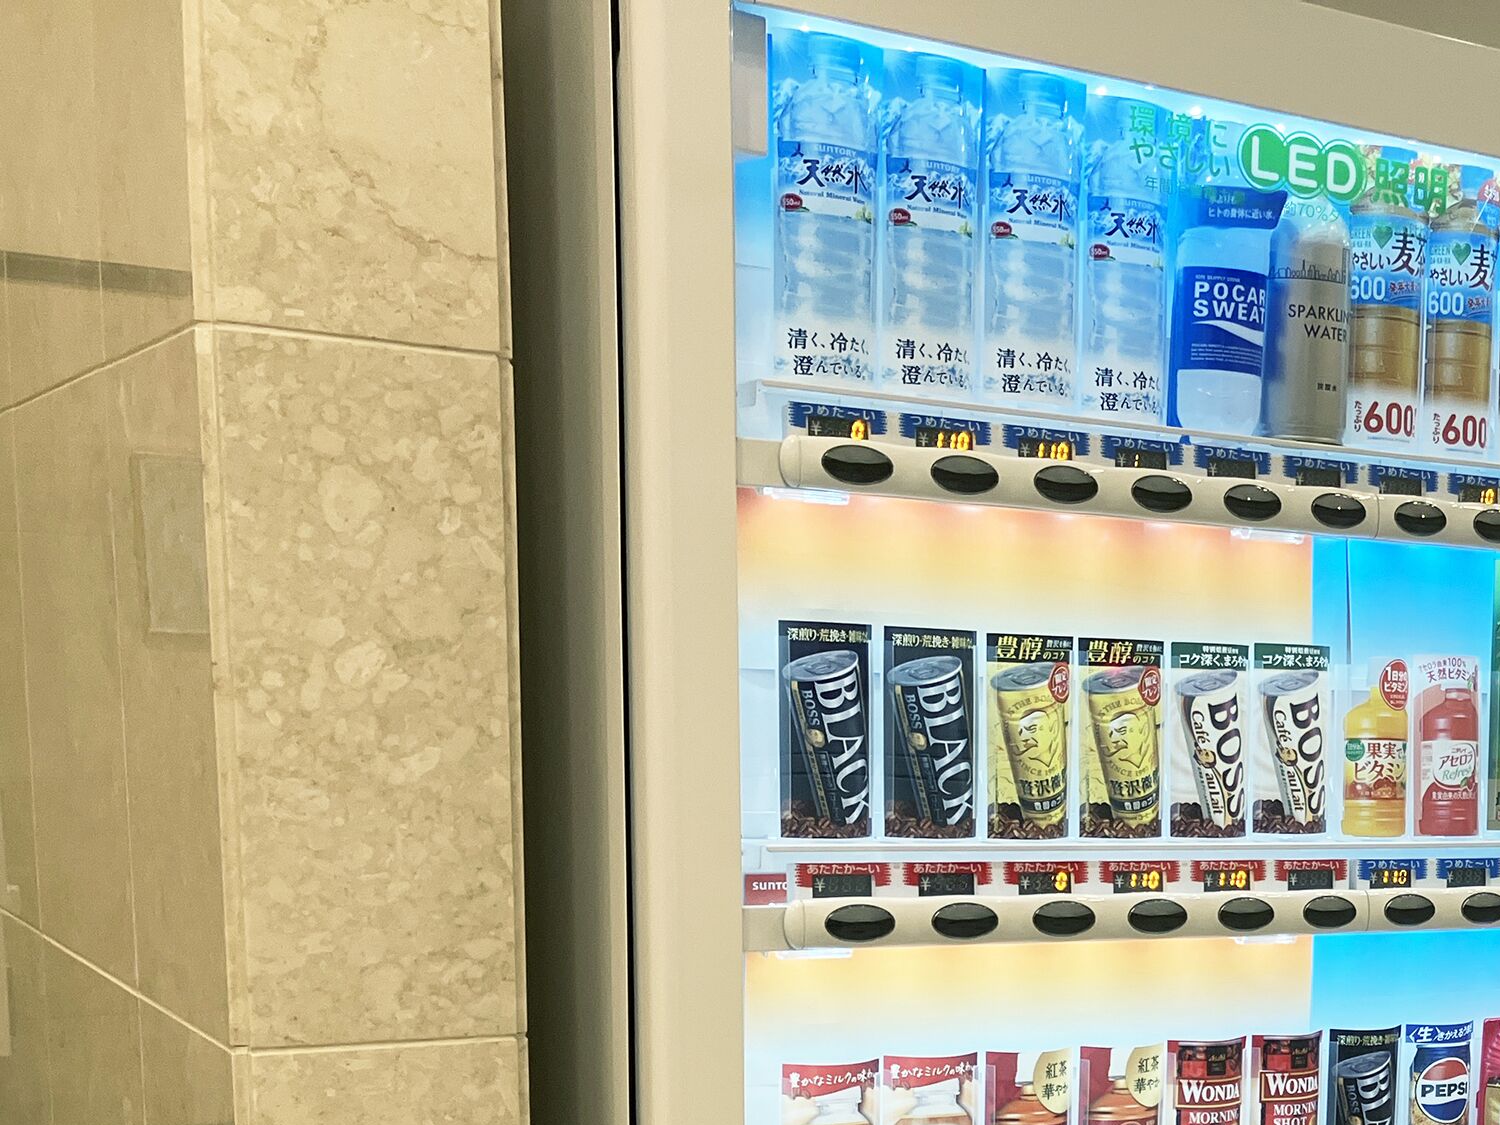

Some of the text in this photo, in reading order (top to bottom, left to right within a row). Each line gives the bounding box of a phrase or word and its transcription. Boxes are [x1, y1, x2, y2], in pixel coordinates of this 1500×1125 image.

[797, 159, 868, 194] 天然水
[1251, 134, 1358, 193] LED
[905, 175, 970, 210] 天然水
[1007, 189, 1071, 222] 天然水
[1105, 213, 1160, 244] 天然水
[1351, 276, 1386, 301] 600
[1428, 291, 1465, 316] 600
[1193, 299, 1265, 325] SWEAT
[1304, 324, 1348, 344] WATER
[1442, 413, 1487, 449] 600
[802, 689, 821, 726] BOSS
[905, 693, 923, 729] BOSS
[1192, 709, 1211, 744] Café
[1274, 709, 1292, 743] Café
[814, 671, 870, 825] BLACK
[917, 675, 973, 826] BLACK
[1207, 692, 1245, 817] BOSS
[1290, 692, 1327, 816] BOSS
[1180, 1079, 1240, 1104] WONDA
[1266, 1073, 1318, 1096] WONDA
[1421, 1083, 1467, 1098] PEPSI
